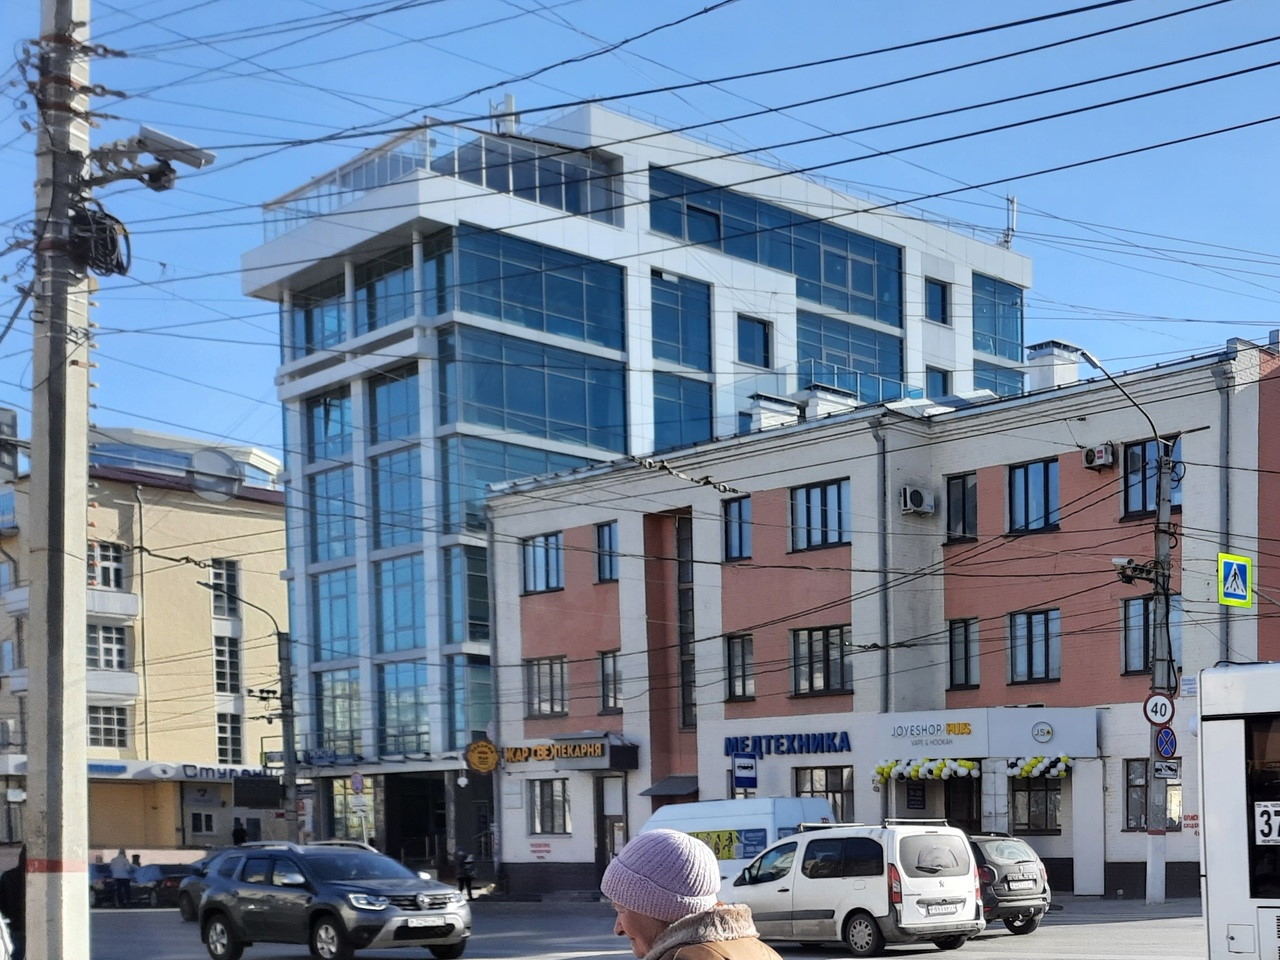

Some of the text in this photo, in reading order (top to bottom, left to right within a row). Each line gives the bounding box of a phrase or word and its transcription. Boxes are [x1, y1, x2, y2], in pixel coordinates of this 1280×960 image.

[1151, 702, 1167, 717] 40
[891, 722, 972, 737] JOYESHOP PLUS
[724, 732, 852, 760] МЕДТЕХНИКА
[911, 739, 924, 747] VAPE
[930, 738, 953, 746] HOOKAH
[504, 747, 530, 763] ЖАР
[554, 743, 602, 758] ПЕКАРНЯ
